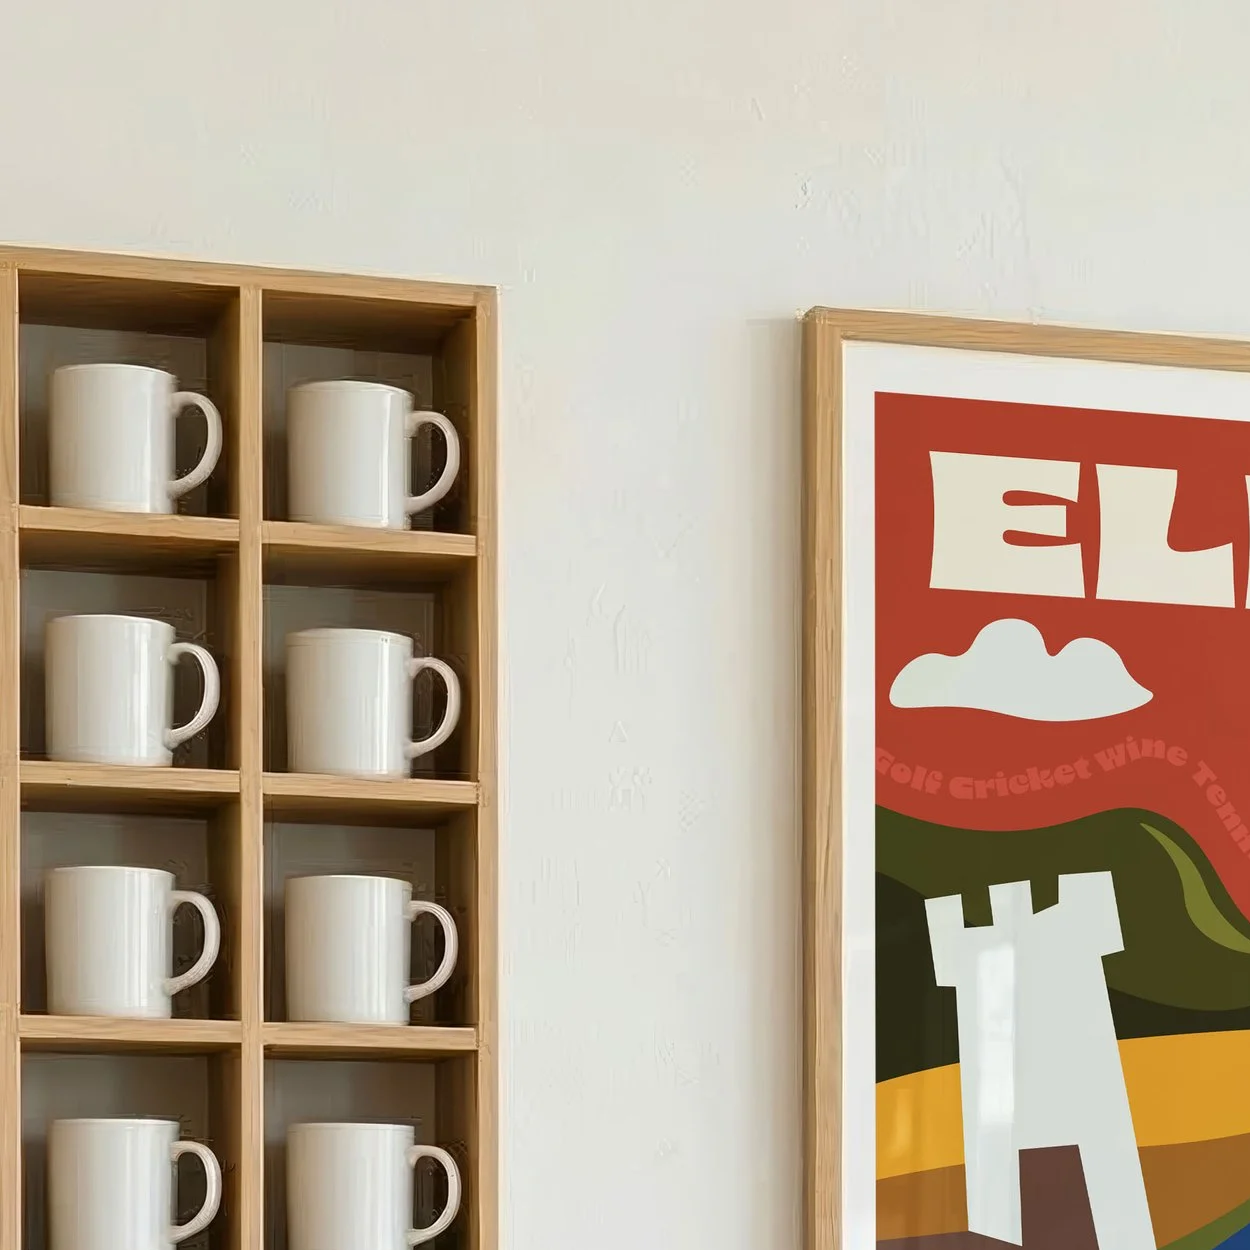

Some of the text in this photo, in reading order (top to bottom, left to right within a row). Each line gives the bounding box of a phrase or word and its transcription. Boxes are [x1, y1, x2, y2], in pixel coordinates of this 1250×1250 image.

[876, 747, 944, 795] Golf
[949, 757, 1092, 799] Cricket
[1094, 736, 1188, 772] Wine
